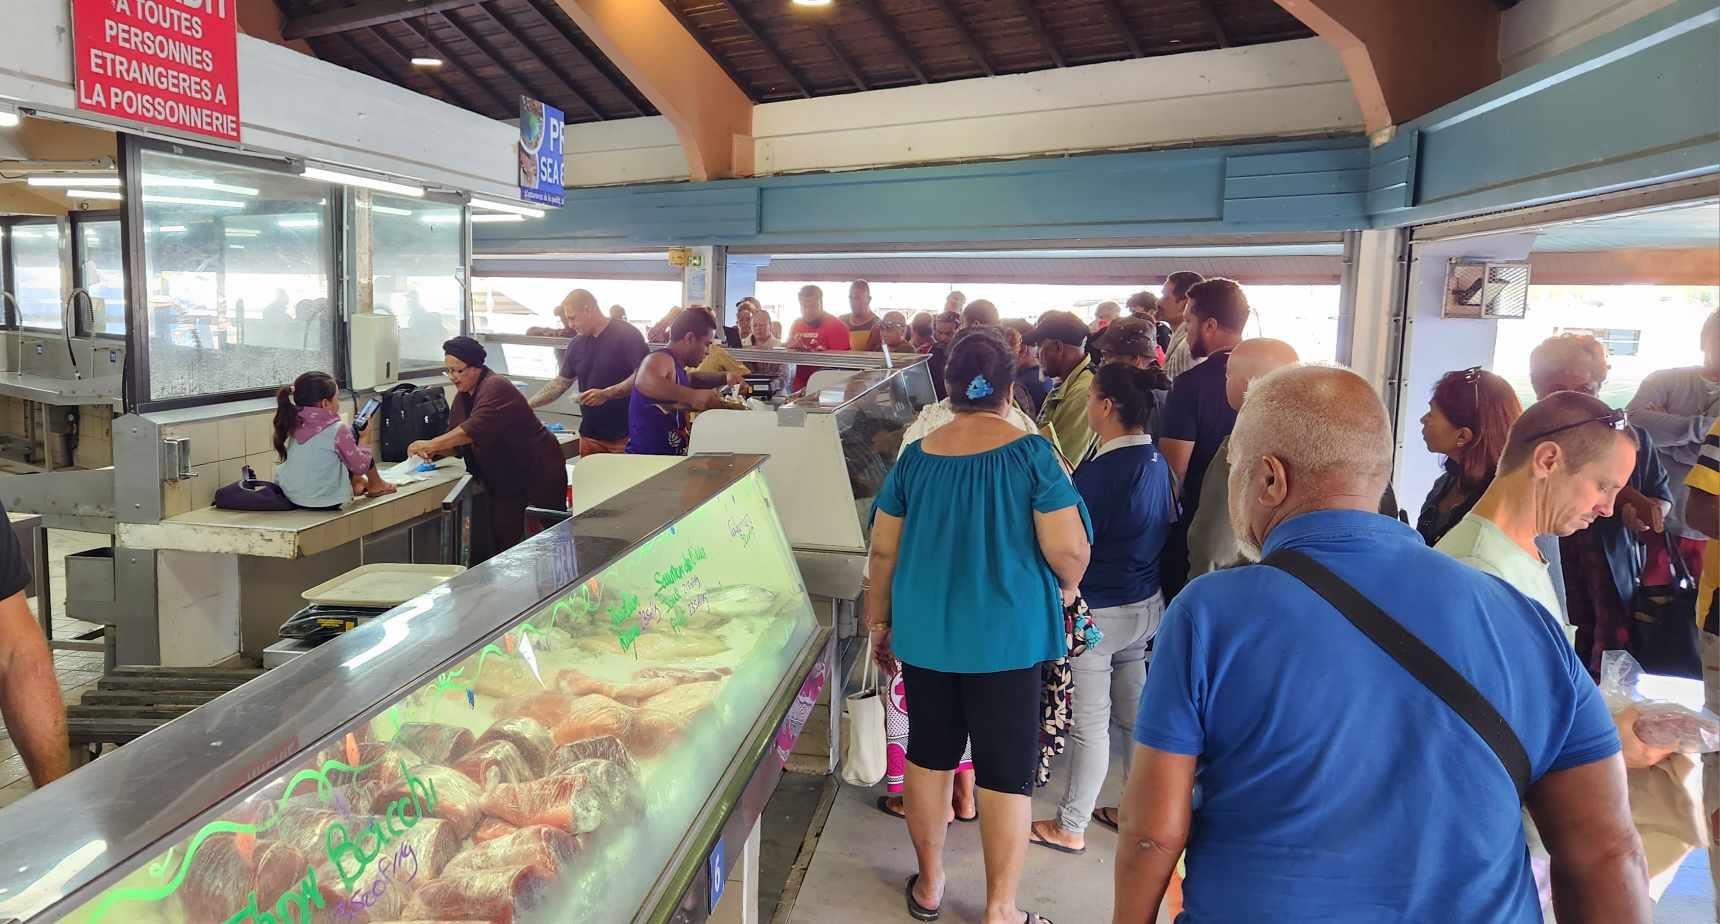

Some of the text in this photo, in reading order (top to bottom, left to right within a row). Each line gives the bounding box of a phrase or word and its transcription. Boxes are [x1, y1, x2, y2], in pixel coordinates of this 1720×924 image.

[105, 19, 214, 72] PERSONNES
[116, 0, 131, 16] A
[136, 0, 203, 39] TOUTES
[90, 48, 227, 105] ETRANGERES A
[79, 79, 238, 137] LA POISSONNERIE
[714, 853, 721, 893] 6
